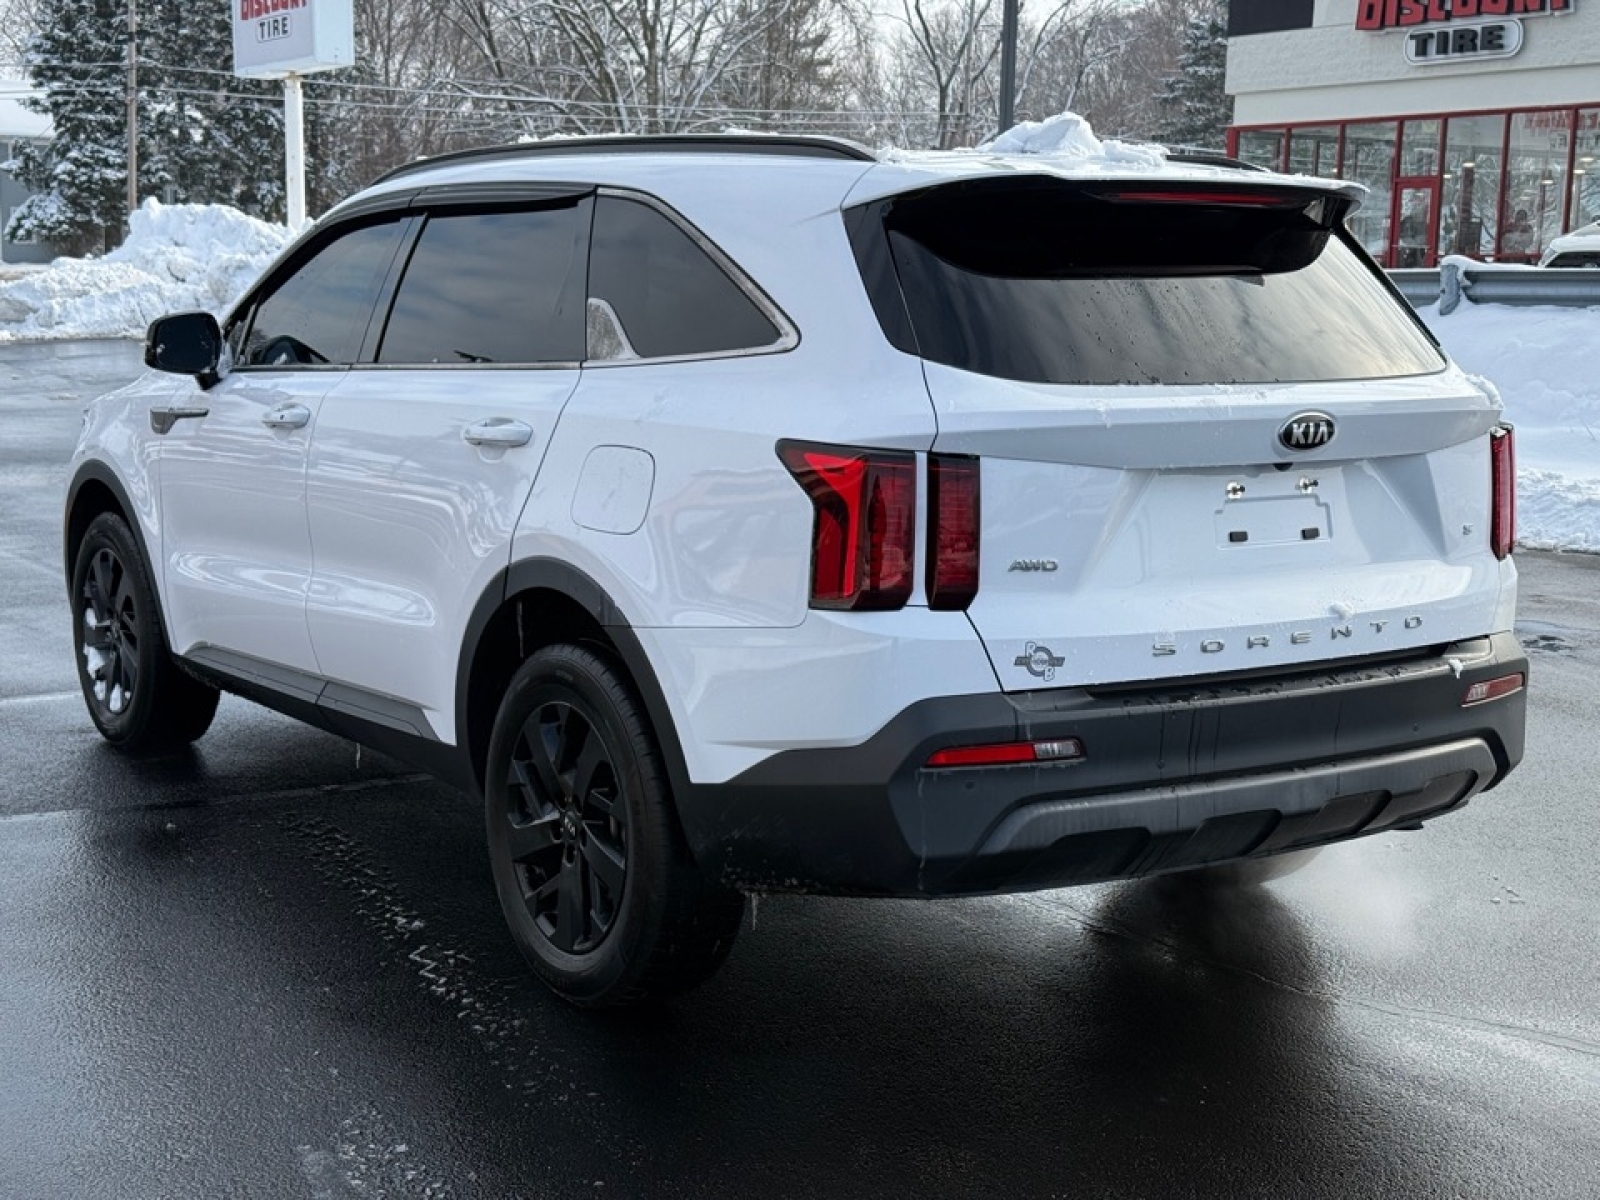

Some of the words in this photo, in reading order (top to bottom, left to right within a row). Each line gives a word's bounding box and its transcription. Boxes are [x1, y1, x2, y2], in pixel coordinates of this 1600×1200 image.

[241, 0, 308, 20] DISC
[1355, 0, 1570, 30] DISC
[259, 17, 289, 39] TIRE
[1409, 25, 1504, 57] TIRE
[1289, 421, 1329, 445] KIA
[1008, 559, 1058, 572] AWD
[1152, 615, 1423, 657] SORENTO
